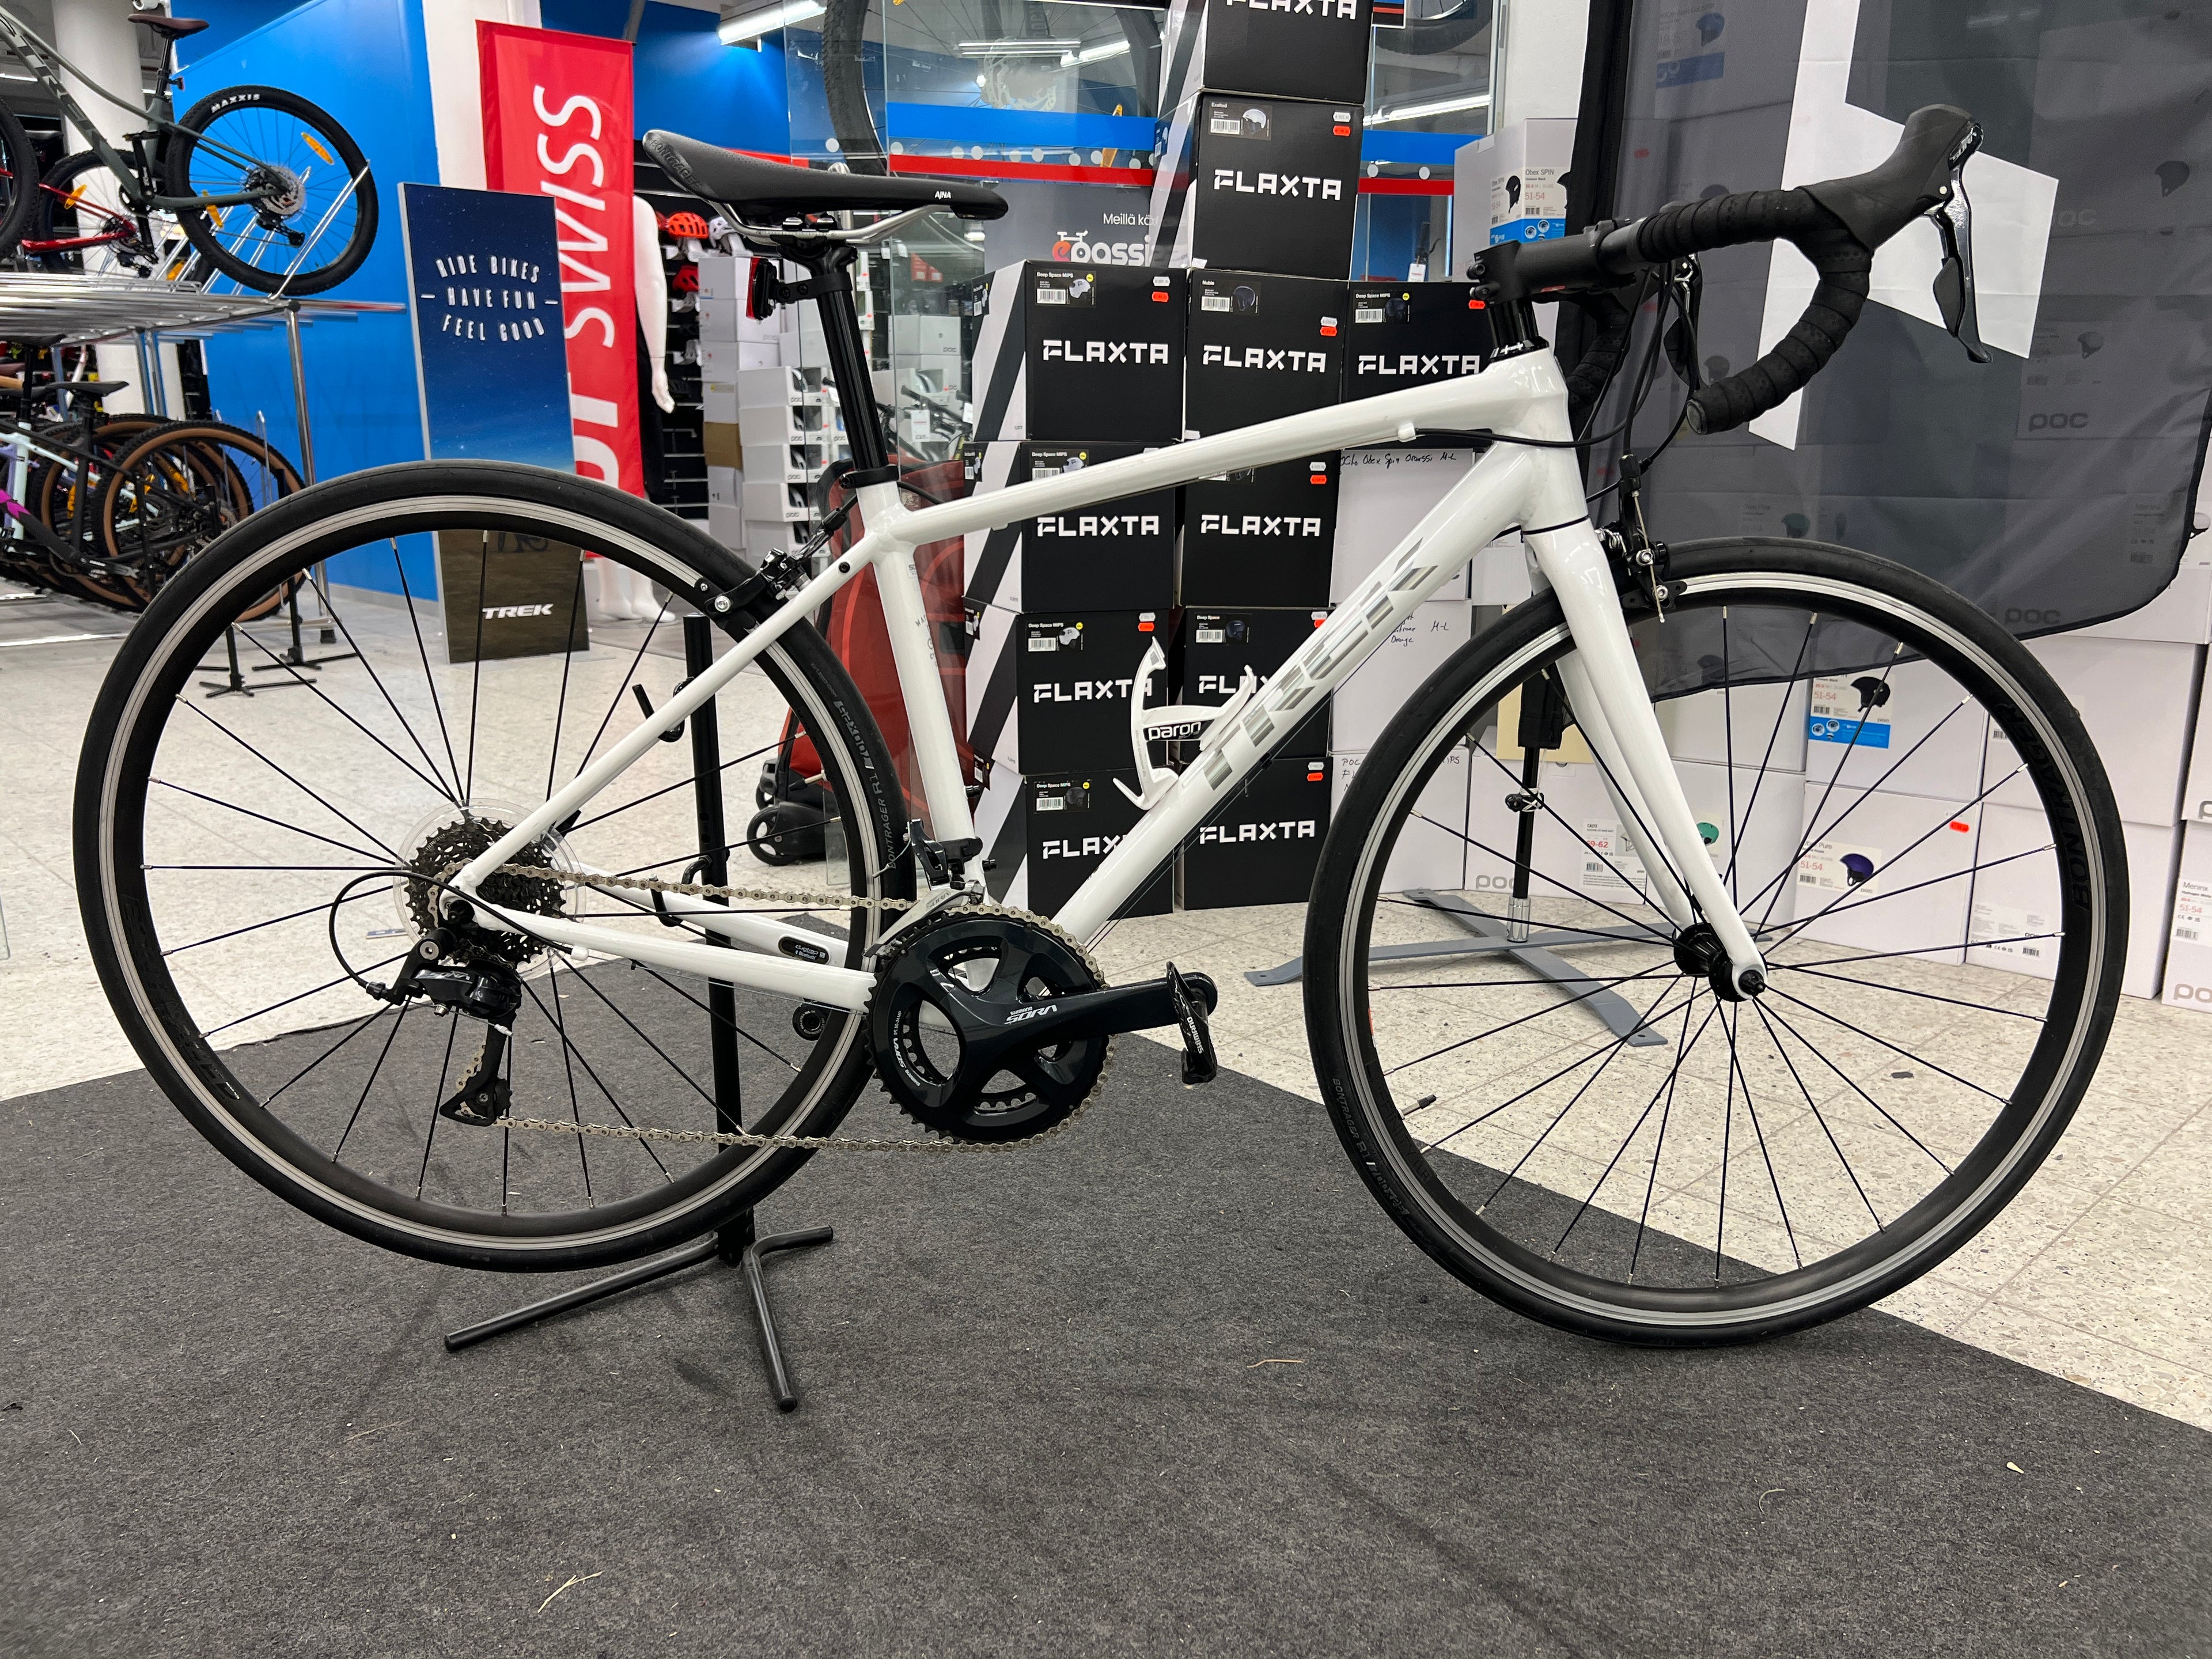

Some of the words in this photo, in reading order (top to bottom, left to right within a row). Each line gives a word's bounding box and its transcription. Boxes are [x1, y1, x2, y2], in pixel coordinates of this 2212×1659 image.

[1226, 0, 1357, 20] AXTA
[211, 94, 260, 113] MAXXIS
[1214, 169, 1342, 200] FLAXTA
[533, 85, 615, 349] SWISS
[1103, 213, 1135, 225] Meillä
[435, 255, 477, 278] RIDE
[490, 256, 539, 283] BIKES
[447, 287, 493, 308] HAVE
[503, 290, 535, 309] FUN
[442, 314, 486, 341] FEEL
[499, 318, 544, 342] GOOD
[1043, 339, 1168, 364] FLAXTA
[1203, 345, 1326, 373] FLAXTA
[1358, 355, 1480, 374] FLAXTA
[1037, 516, 1159, 537] FLAXTA
[1200, 514, 1321, 536] FLAXTA
[482, 603, 554, 619] TREK
[1199, 675, 1268, 694] FLA
[1814, 691, 1837, 700] 51-54
[1148, 722, 1201, 741] paron
[1342, 758, 1361, 766] POC
[1442, 756, 1460, 764] IPS
[870, 772, 882, 795] R1
[879, 798, 897, 869] BONTRAGER
[1199, 820, 1316, 844] FLAXTA
[1043, 835, 1127, 859] FLAX
[1800, 861, 1823, 870] 51-54
[2179, 904, 2202, 914] 51-54
[1004, 1005, 1058, 1025] SORA
[1010, 1006, 1033, 1016] SHIMANO
[1187, 1016, 1204, 1054] SHIMANO
[893, 1037, 907, 1069] SORA
[1332, 1078, 1360, 1139] BONTRAGER
[1357, 1141, 1370, 1160] R1
